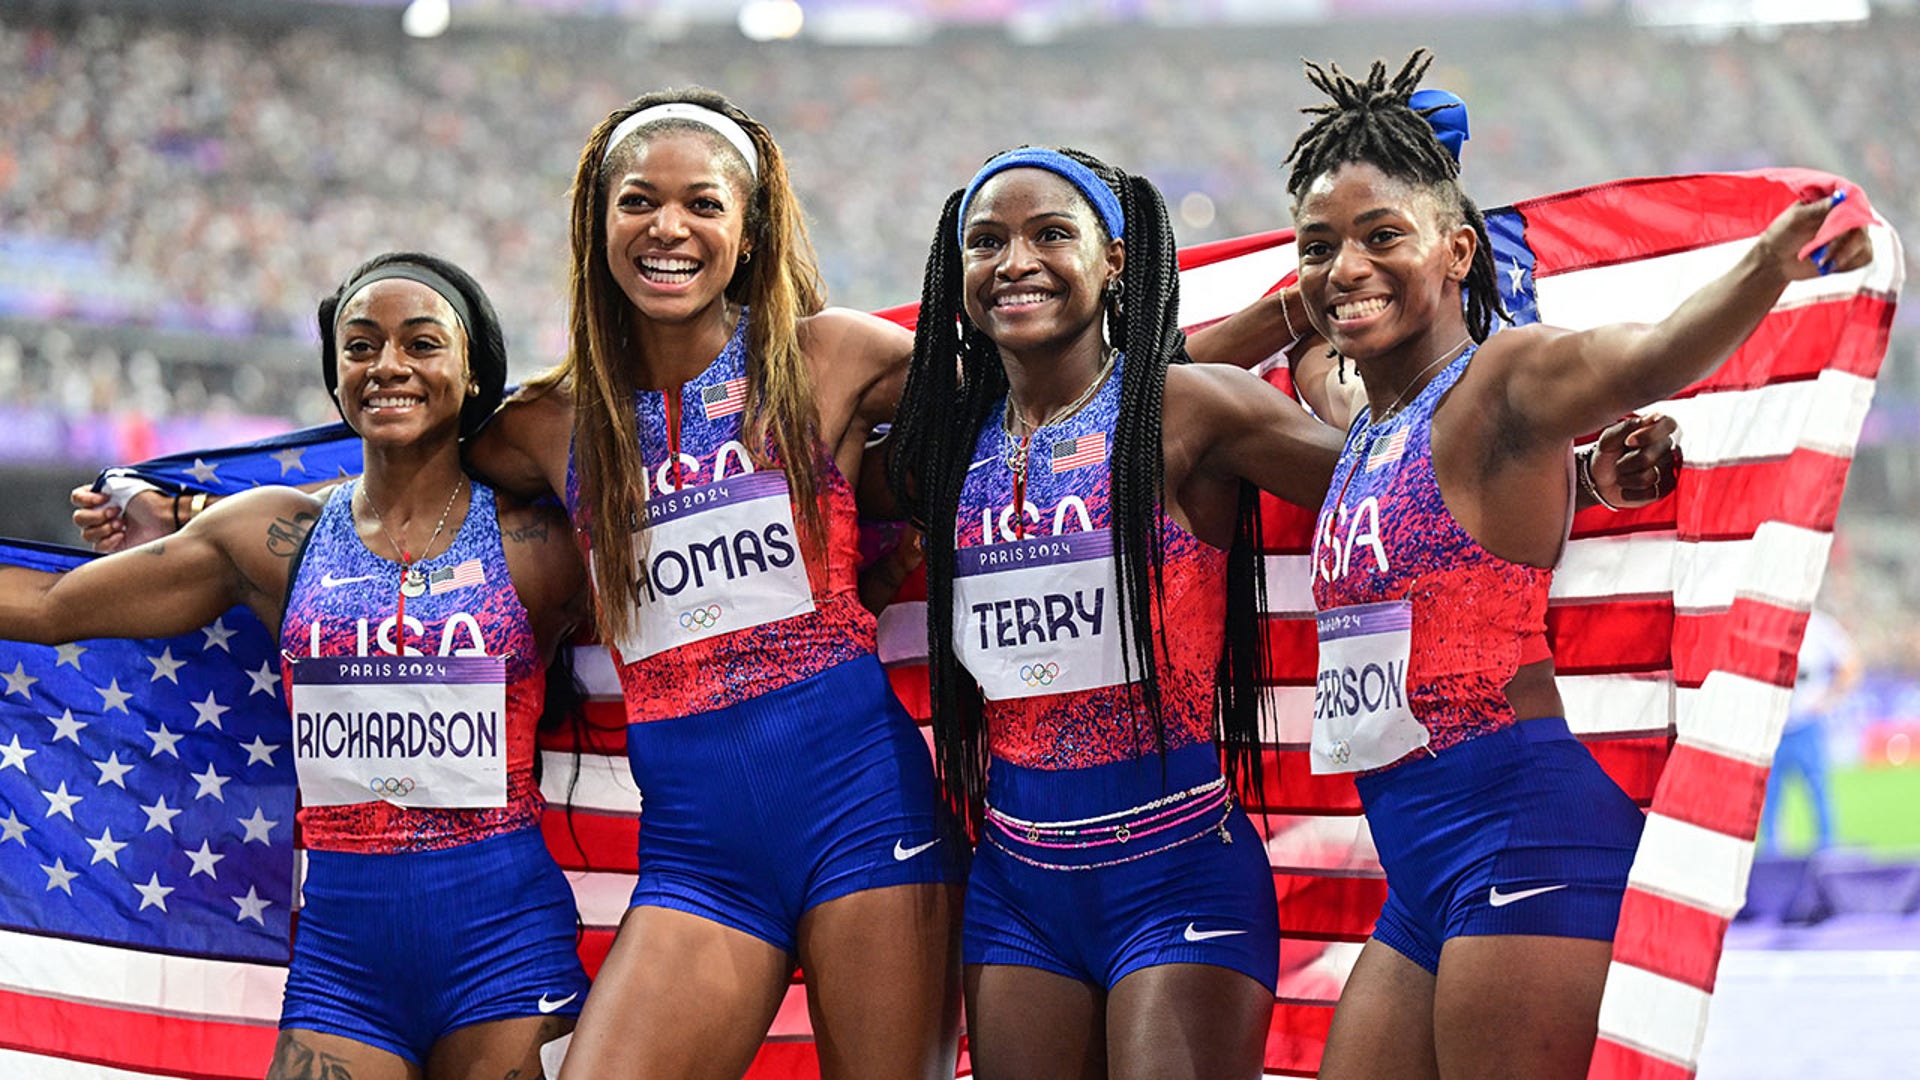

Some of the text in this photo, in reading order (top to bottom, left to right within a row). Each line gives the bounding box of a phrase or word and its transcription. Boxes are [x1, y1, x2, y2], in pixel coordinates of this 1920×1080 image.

[642, 439, 755, 498] SA
[683, 487, 730, 509] 2024
[634, 522, 796, 607] HOMAS
[979, 542, 1072, 566] PARIS 2024
[971, 587, 1105, 650] TERRY
[340, 663, 447, 677] PARIS 2024
[296, 711, 498, 759] RICHARDSON
